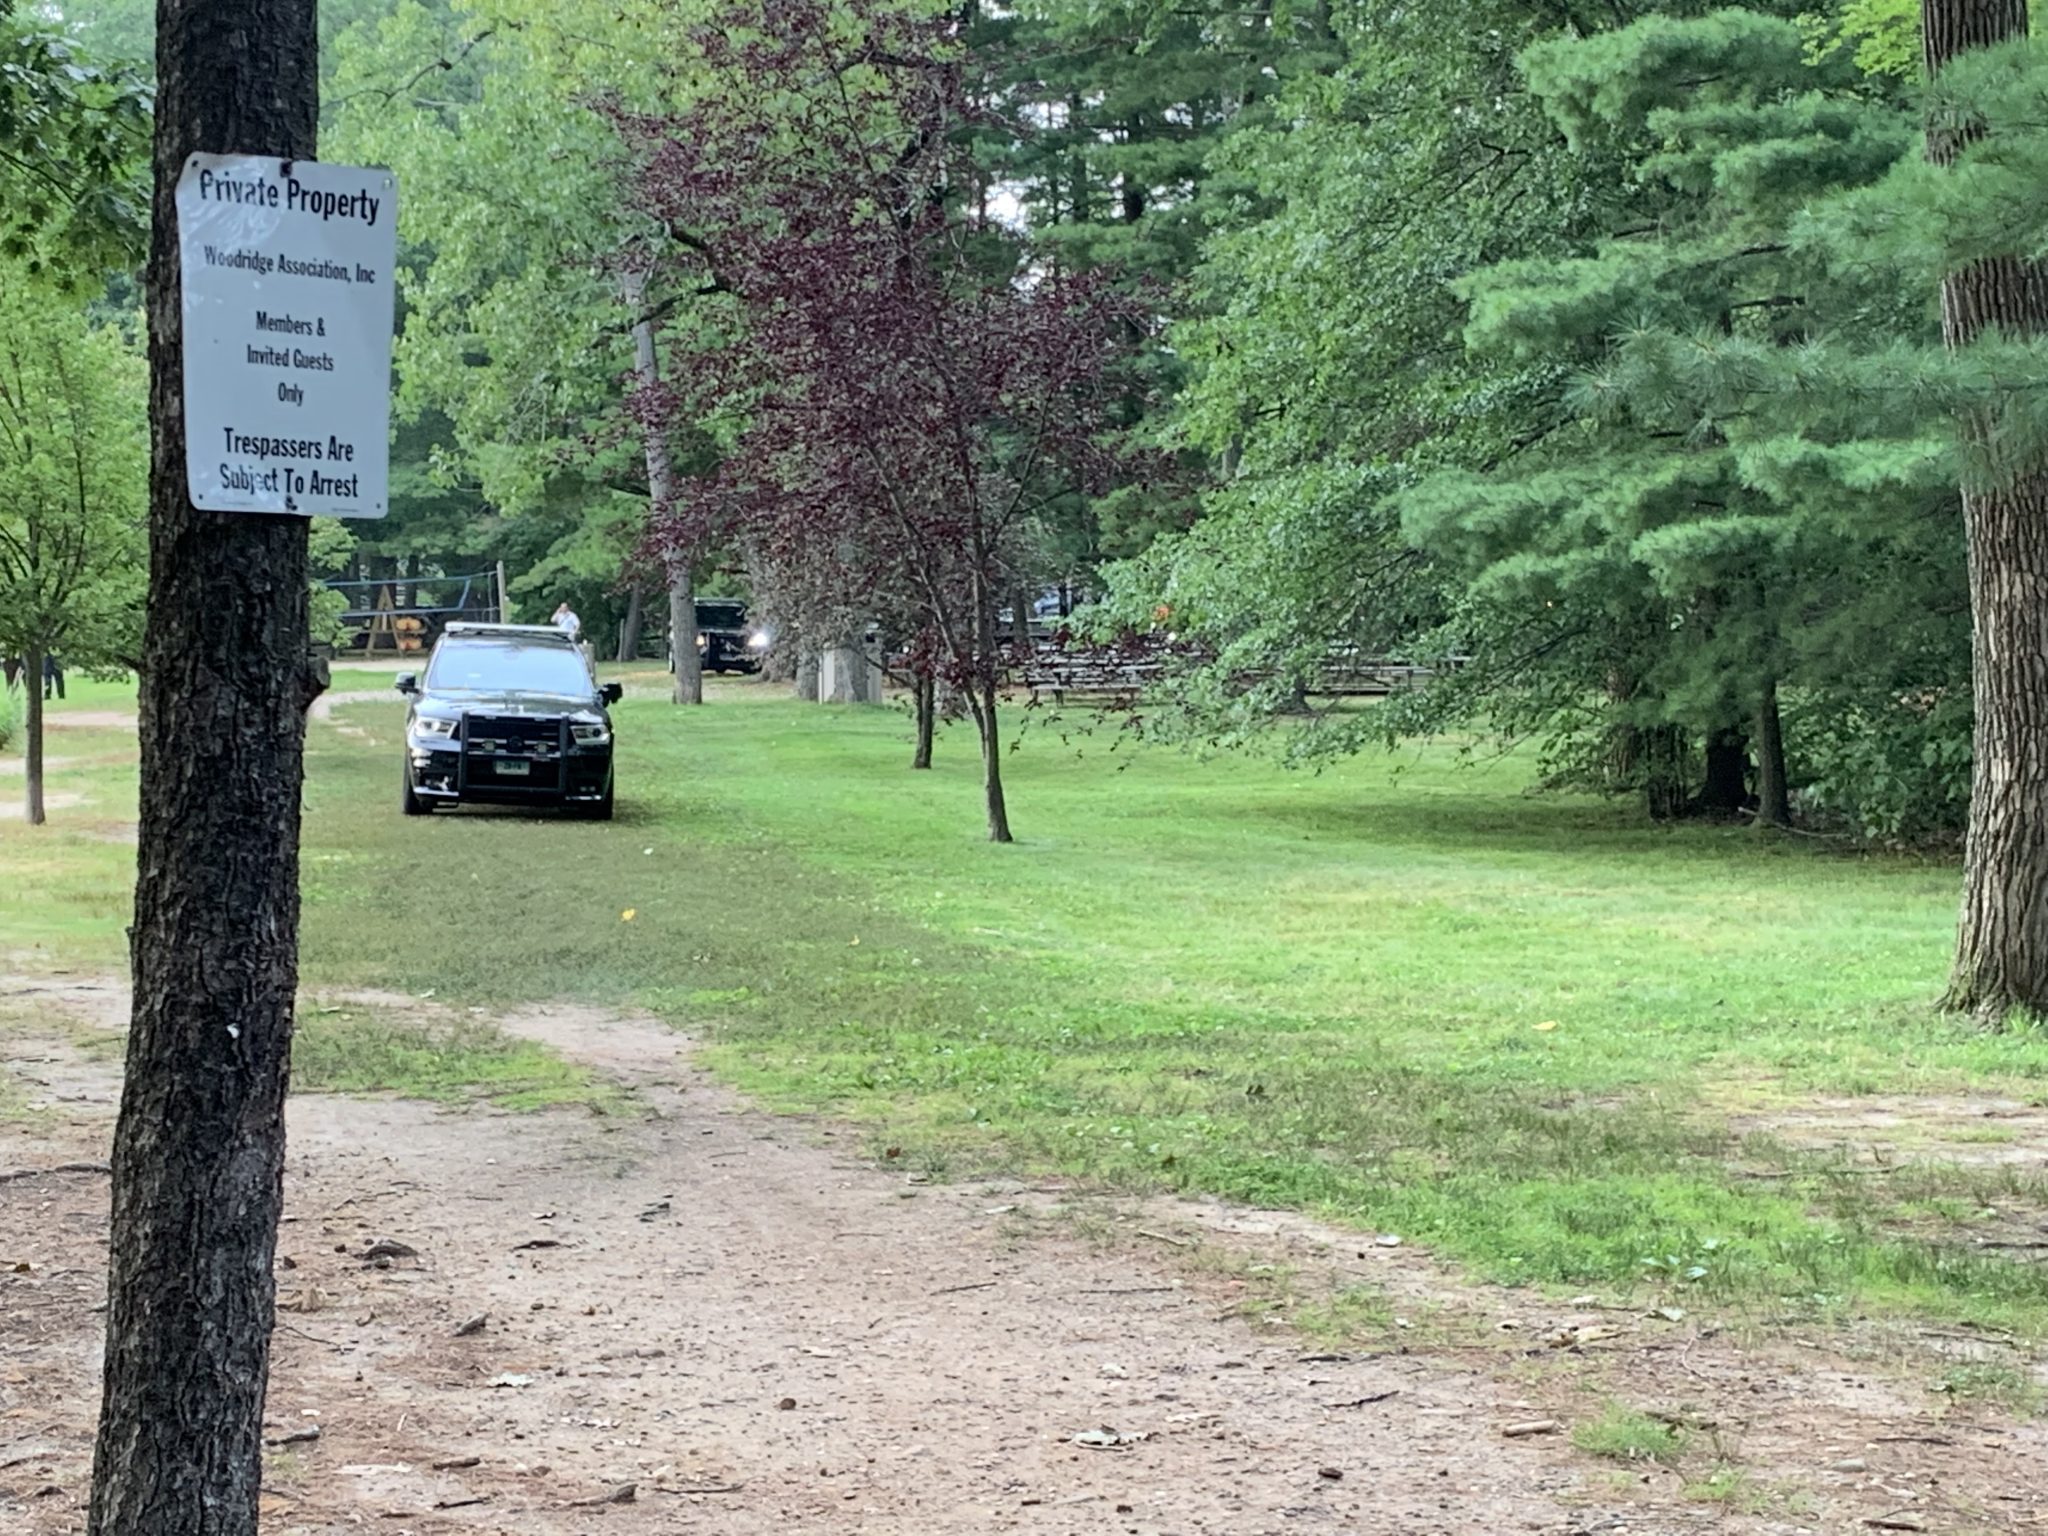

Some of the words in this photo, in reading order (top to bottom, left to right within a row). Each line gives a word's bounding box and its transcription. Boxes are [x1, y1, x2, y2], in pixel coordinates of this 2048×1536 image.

[200, 168, 279, 208] Private
[287, 178, 380, 226] Property
[204, 245, 274, 275] Woodridge
[277, 254, 352, 283] Association,
[356, 263, 376, 284] Inc
[256, 310, 313, 336] Members
[316, 317, 326, 337] &
[247, 344, 290, 368] Invited
[293, 348, 334, 372] Guests
[278, 382, 304, 407] Only
[223, 427, 323, 460] Trespassers
[327, 435, 354, 462] Are
[219, 463, 278, 495] Subject
[284, 468, 305, 494] To
[309, 470, 358, 498] Arrest
